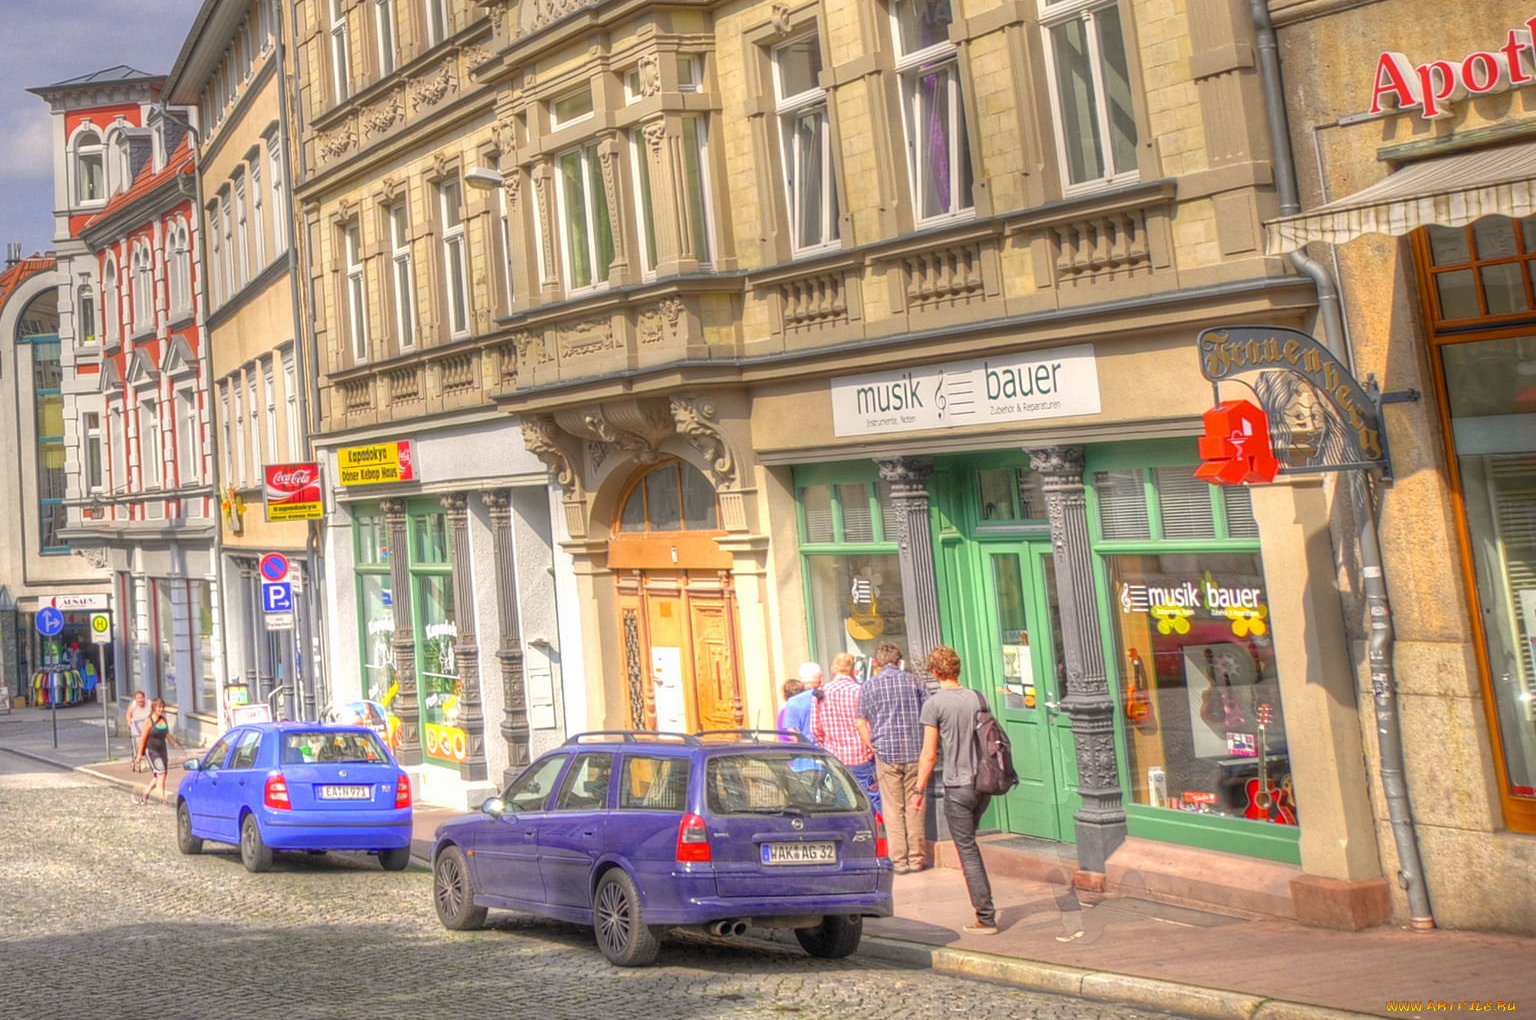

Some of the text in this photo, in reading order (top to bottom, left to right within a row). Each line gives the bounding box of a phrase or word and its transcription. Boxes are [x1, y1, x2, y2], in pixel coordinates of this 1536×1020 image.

[856, 361, 1062, 415] musik bauer
[1201, 330, 1383, 460] Frauenberg
[990, 400, 1062, 415] Zubehör & Reparaturen
[348, 447, 387, 463] Kapadokya
[341, 466, 398, 482] Döner Kebap Haus
[269, 585, 285, 608] P
[1148, 581, 1261, 608] musik bauer
[350, 786, 366, 797] 971
[770, 844, 835, 861] WAK AG 32
